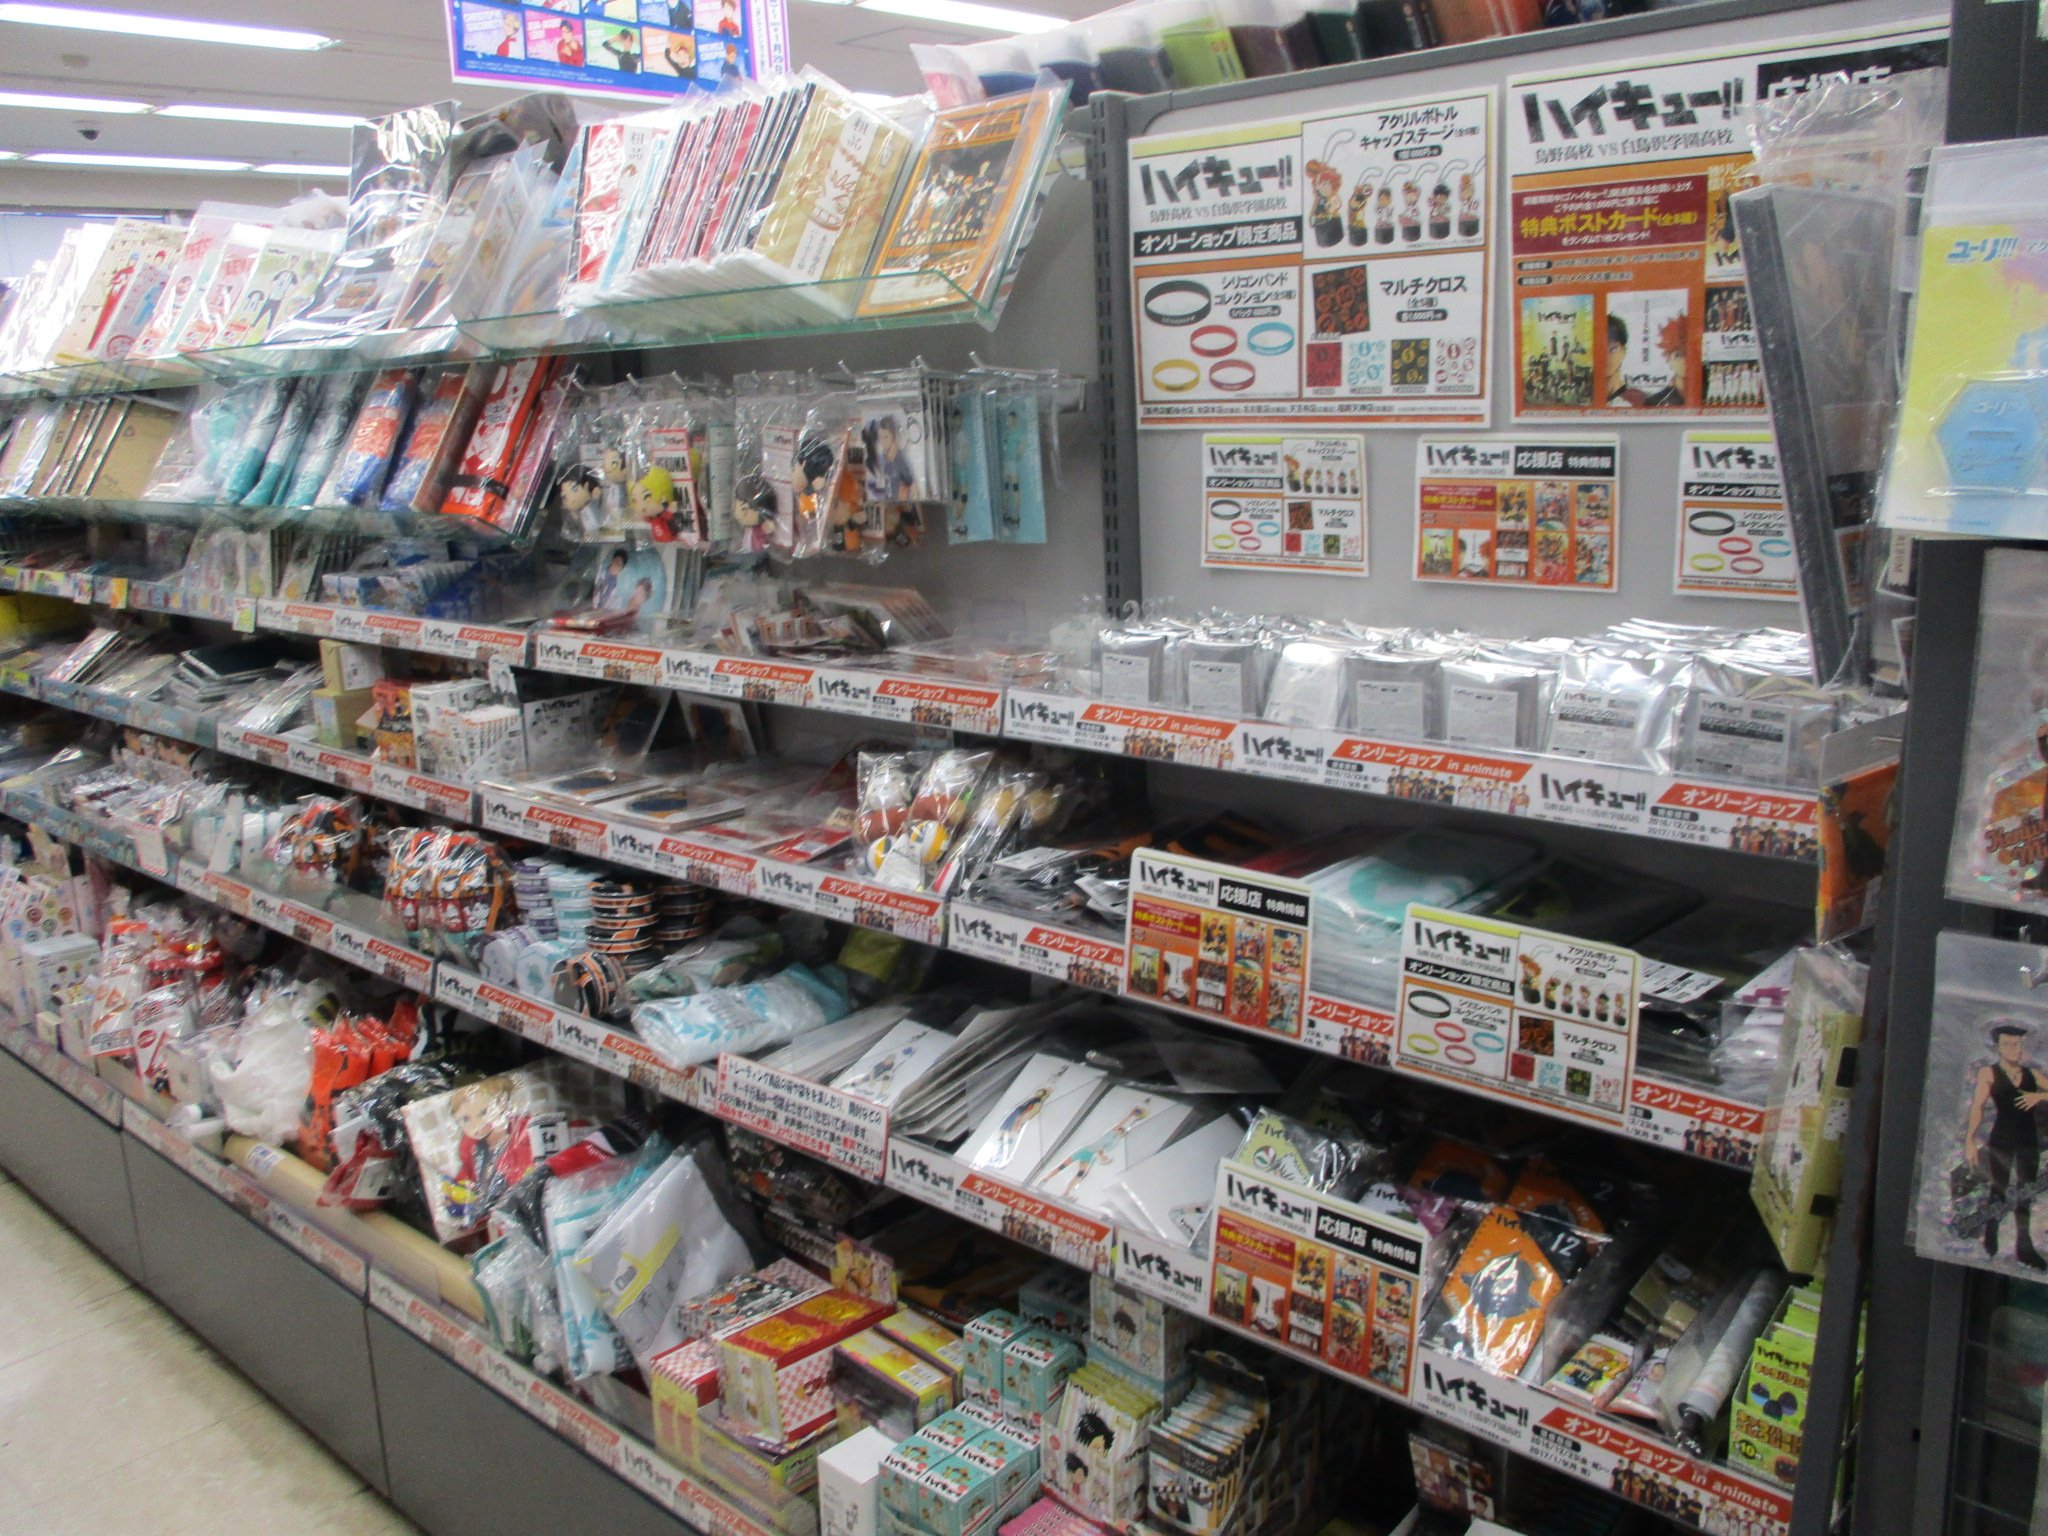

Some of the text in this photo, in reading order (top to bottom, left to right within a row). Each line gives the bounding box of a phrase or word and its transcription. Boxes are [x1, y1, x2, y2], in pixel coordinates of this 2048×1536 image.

[1378, 106, 1459, 131] アクリルボトル
[1522, 78, 1744, 143] ハイキュー!!
[1140, 154, 1293, 206] ハイキュー!!
[1379, 275, 1467, 296] マルチクロス
[1427, 444, 1510, 466] ハイキュー!!
[1010, 698, 1074, 727] ハイキュー!!
[1094, 705, 1168, 729] オンリーショップ
[1181, 722, 1223, 738] animate
[1242, 732, 1514, 779] ハイキュー!! オンリーショップ in animate
[1541, 772, 1648, 812] ハイキュー!!
[1682, 787, 1808, 822] オンリーショップ
[1140, 861, 1215, 896] ハイキュー!!
[1220, 885, 1263, 910] 応援店
[955, 913, 1019, 948] ハイキュー!!
[1038, 931, 1110, 960] オンリーショップ
[1414, 921, 1511, 965] ハイキュー!!
[1636, 1084, 1758, 1129] オンリーショップ
[890, 1149, 954, 1191] ハイキュー!!
[972, 1176, 1041, 1216] オンリーショップ
[1227, 1173, 1313, 1225] ハイキュー!!
[1317, 1214, 1368, 1248] 応援店
[1123, 1240, 1203, 1292] ハイキュー!!
[1550, 1232, 1580, 1257] 12
[1423, 1363, 1530, 1427] ハイキュー!!
[1562, 1414, 1686, 1475] オンリーショップ
[1690, 1470, 1708, 1486] in
[1710, 1479, 1780, 1518] animate
